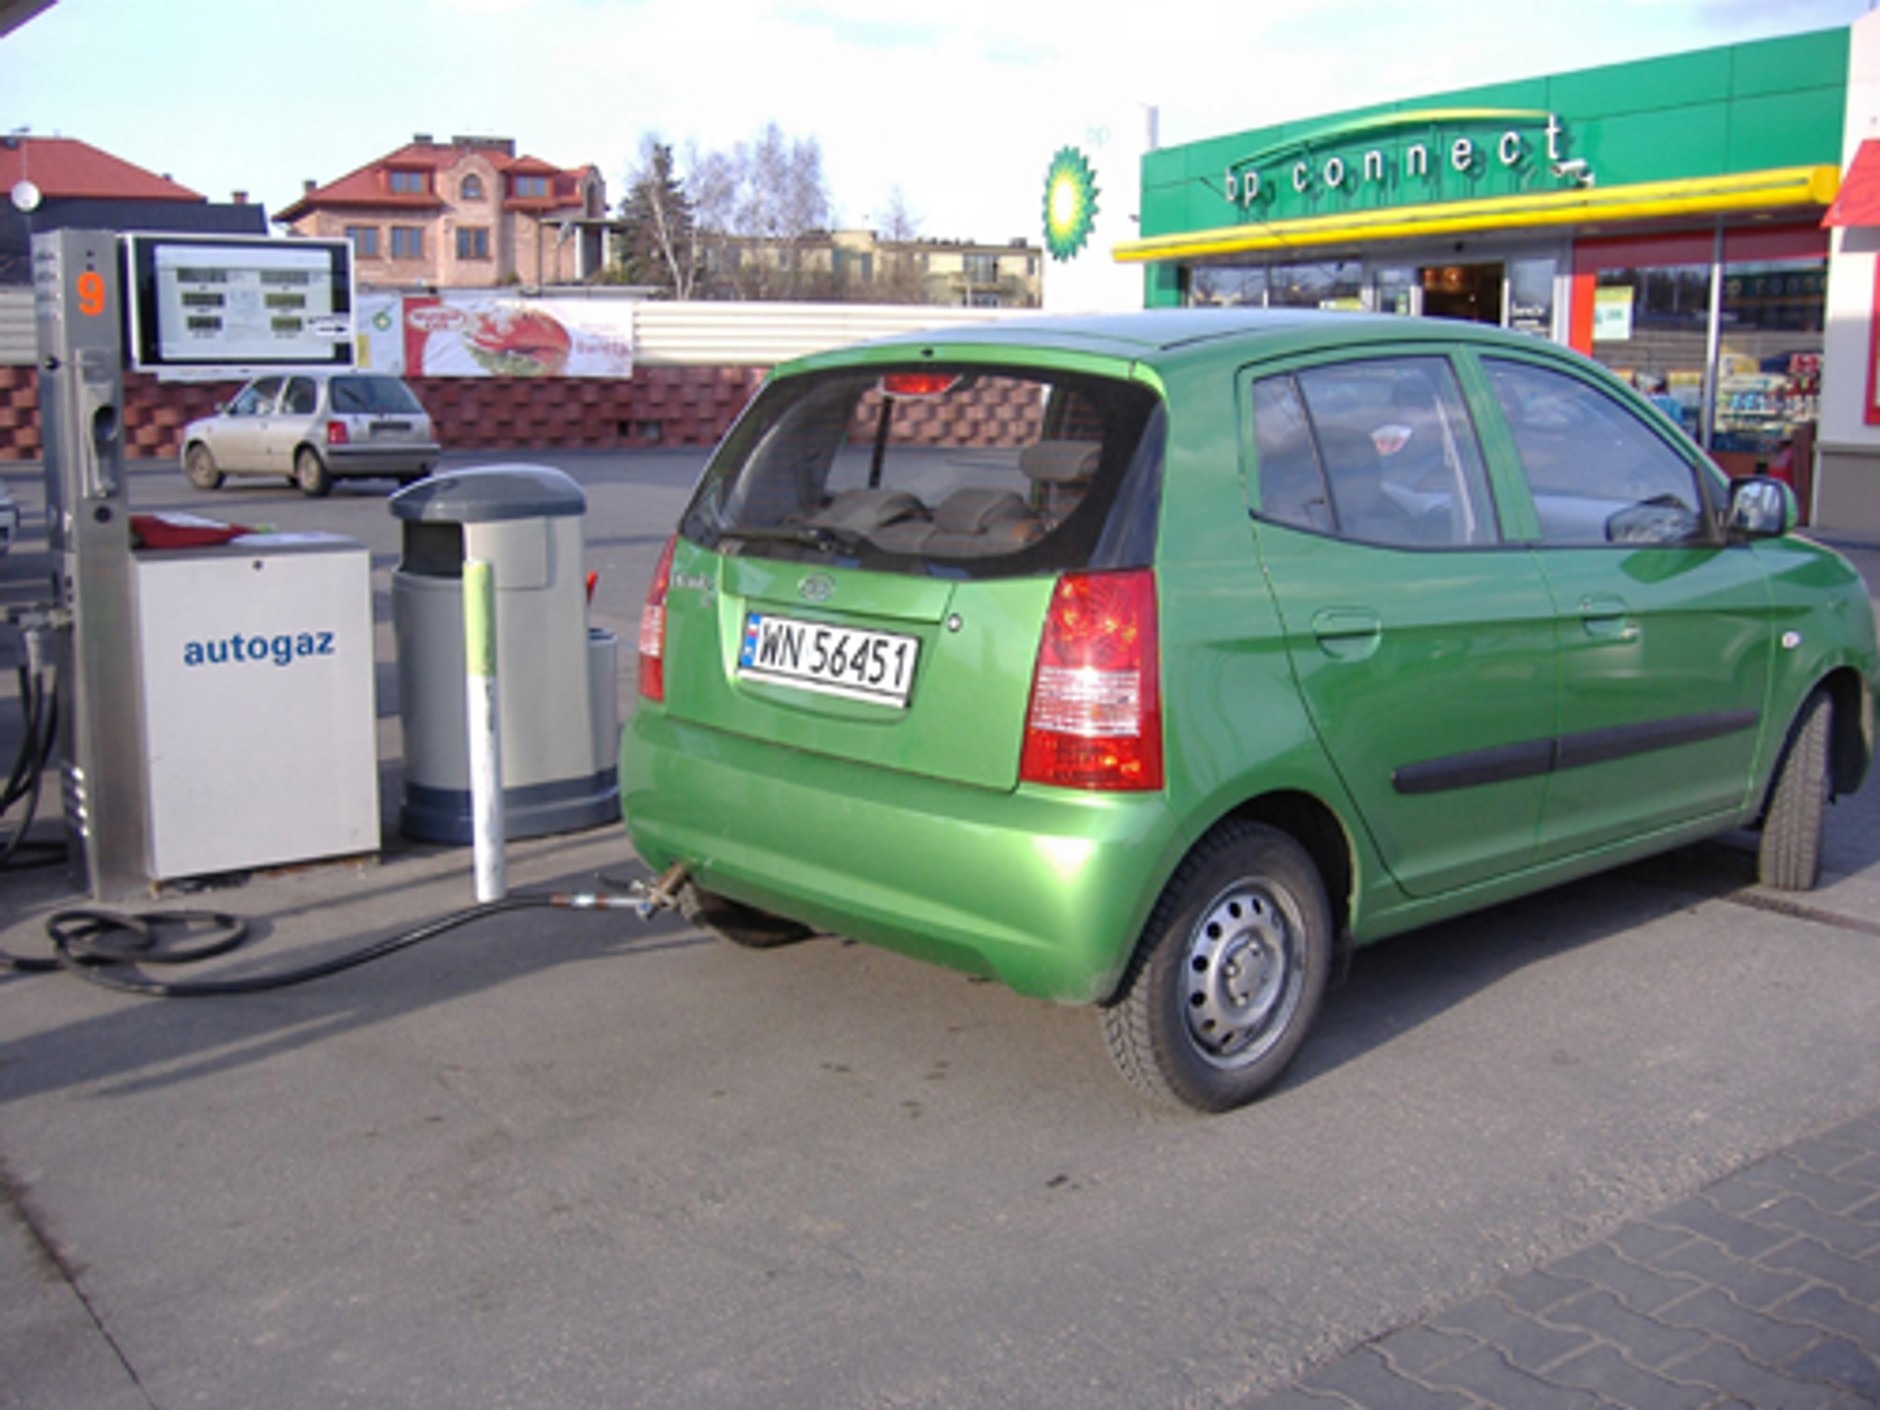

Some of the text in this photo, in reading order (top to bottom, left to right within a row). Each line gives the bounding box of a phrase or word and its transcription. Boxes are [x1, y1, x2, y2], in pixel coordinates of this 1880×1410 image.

[1224, 113, 1562, 209] bp connect
[77, 272, 106, 316] 9
[183, 630, 336, 667] autogaz
[759, 621, 908, 688] WN 56451
